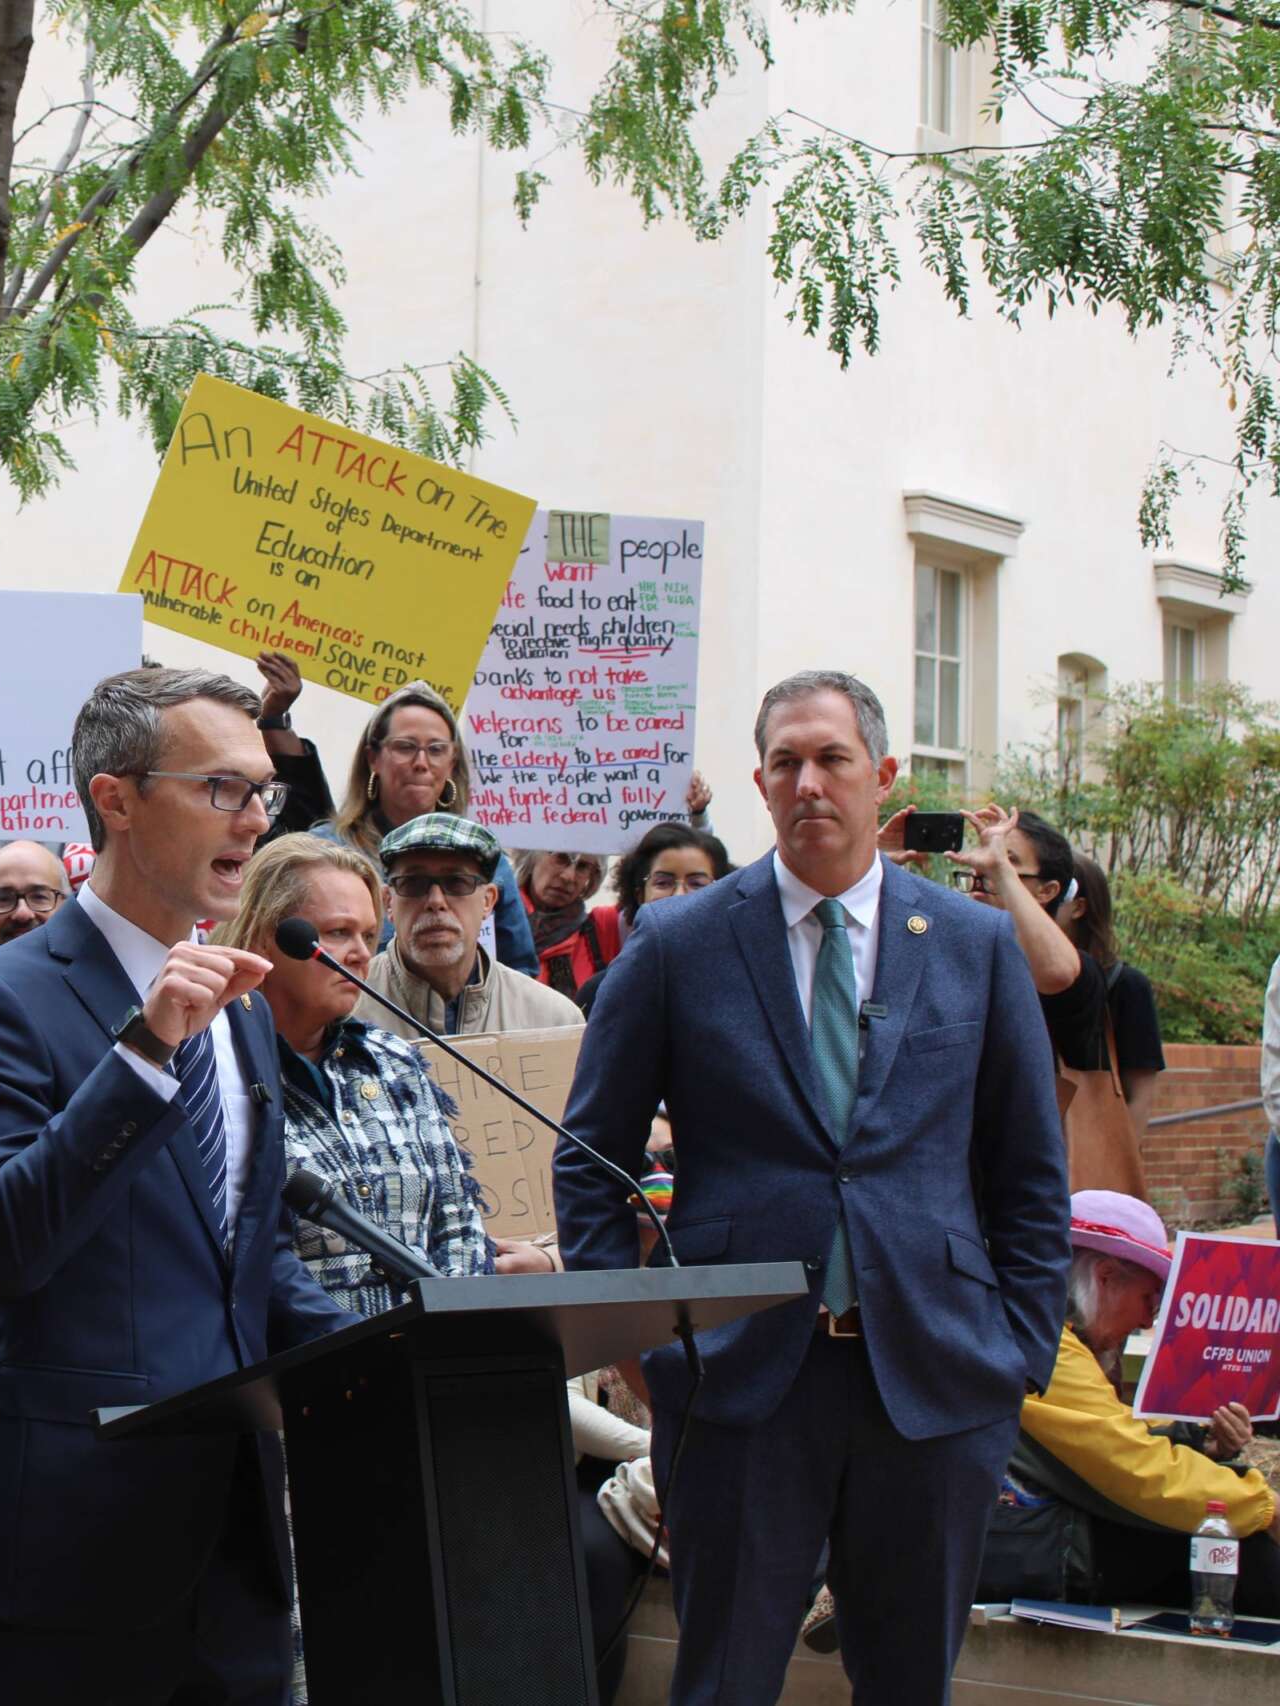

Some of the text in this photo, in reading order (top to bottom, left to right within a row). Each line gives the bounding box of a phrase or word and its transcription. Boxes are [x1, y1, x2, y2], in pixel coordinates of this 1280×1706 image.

[180, 412, 252, 465] An
[277, 424, 407, 497] ATTACK
[233, 466, 299, 505] United
[310, 487, 371, 527] States
[381, 513, 483, 562] Department
[326, 520, 343, 535] of
[256, 521, 375, 580] Education
[552, 513, 604, 557] THE
[620, 530, 702, 574] people
[295, 569, 320, 590] an
[134, 550, 238, 607] ATTACK
[280, 600, 365, 647] America's
[372, 640, 426, 667] most
[537, 585, 573, 609] food
[581, 589, 602, 610] to
[607, 587, 637, 611] eat
[491, 616, 534, 638] ecial
[544, 615, 590, 639] needs
[601, 614, 675, 635] children
[618, 634, 675, 656] quality
[382, 667, 408, 686] ED
[544, 667, 562, 685] to
[568, 666, 597, 685] not
[605, 666, 648, 685] take
[501, 683, 583, 707] advantage
[593, 687, 616, 700] us
[576, 710, 598, 732] to
[606, 712, 629, 732] be
[635, 711, 684, 731] cared
[499, 729, 528, 748] for
[27, 747, 72, 785] aff
[502, 750, 568, 773] elderly
[575, 747, 591, 764] to
[595, 747, 616, 764] be
[663, 743, 690, 763] for
[512, 767, 538, 782] the
[548, 767, 597, 787] people
[604, 763, 638, 783] want
[647, 768, 660, 783] a
[509, 787, 568, 809] funded
[577, 787, 612, 806] and
[622, 787, 666, 809] fully
[543, 807, 608, 825] federal
[1203, 1346, 1272, 1363] CFPB UNION
